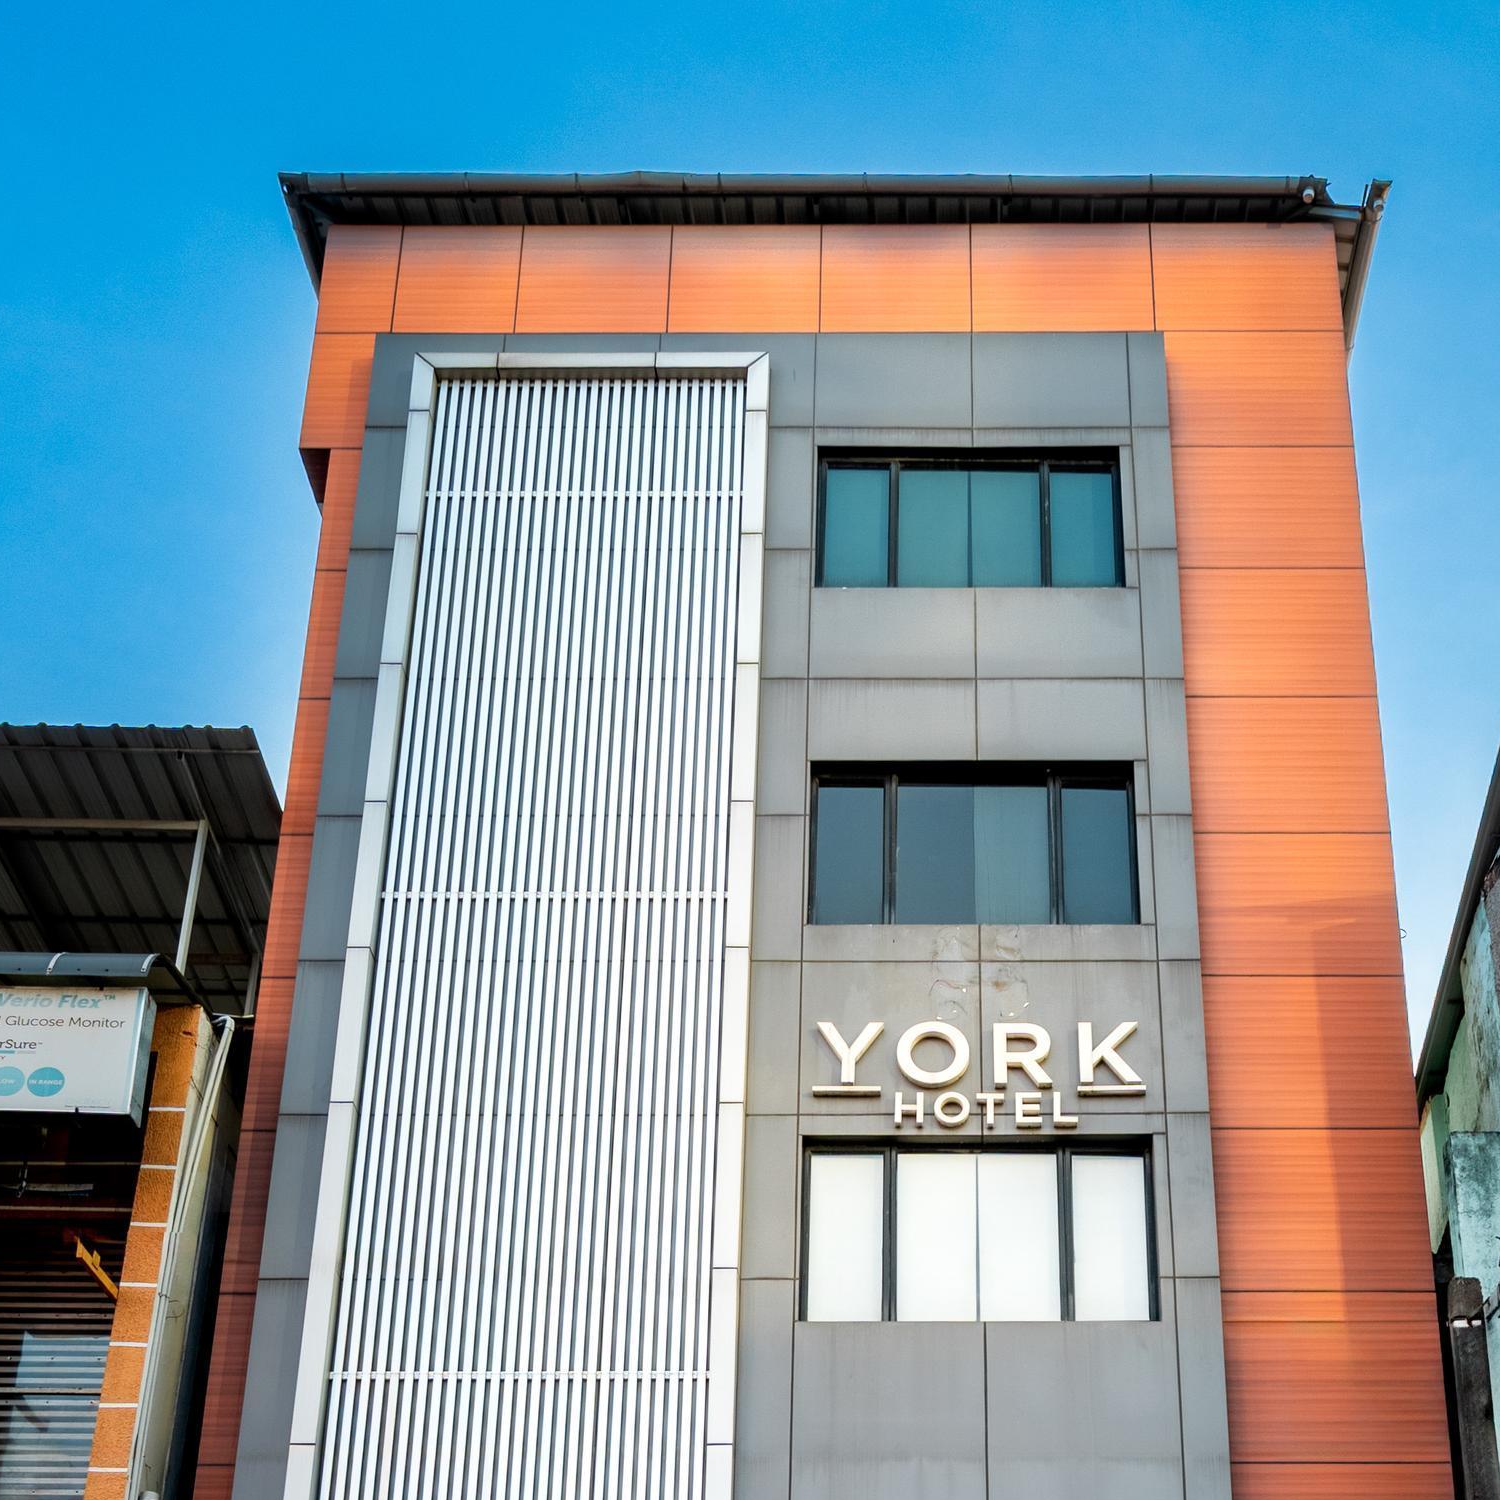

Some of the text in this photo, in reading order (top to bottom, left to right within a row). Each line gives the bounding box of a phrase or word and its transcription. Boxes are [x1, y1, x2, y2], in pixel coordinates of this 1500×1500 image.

[5, 1015, 64, 1028] Glucose
[68, 1016, 126, 1029] Monitor
[815, 1020, 1143, 1090] YORK
[894, 1091, 1080, 1130] HOTEL
